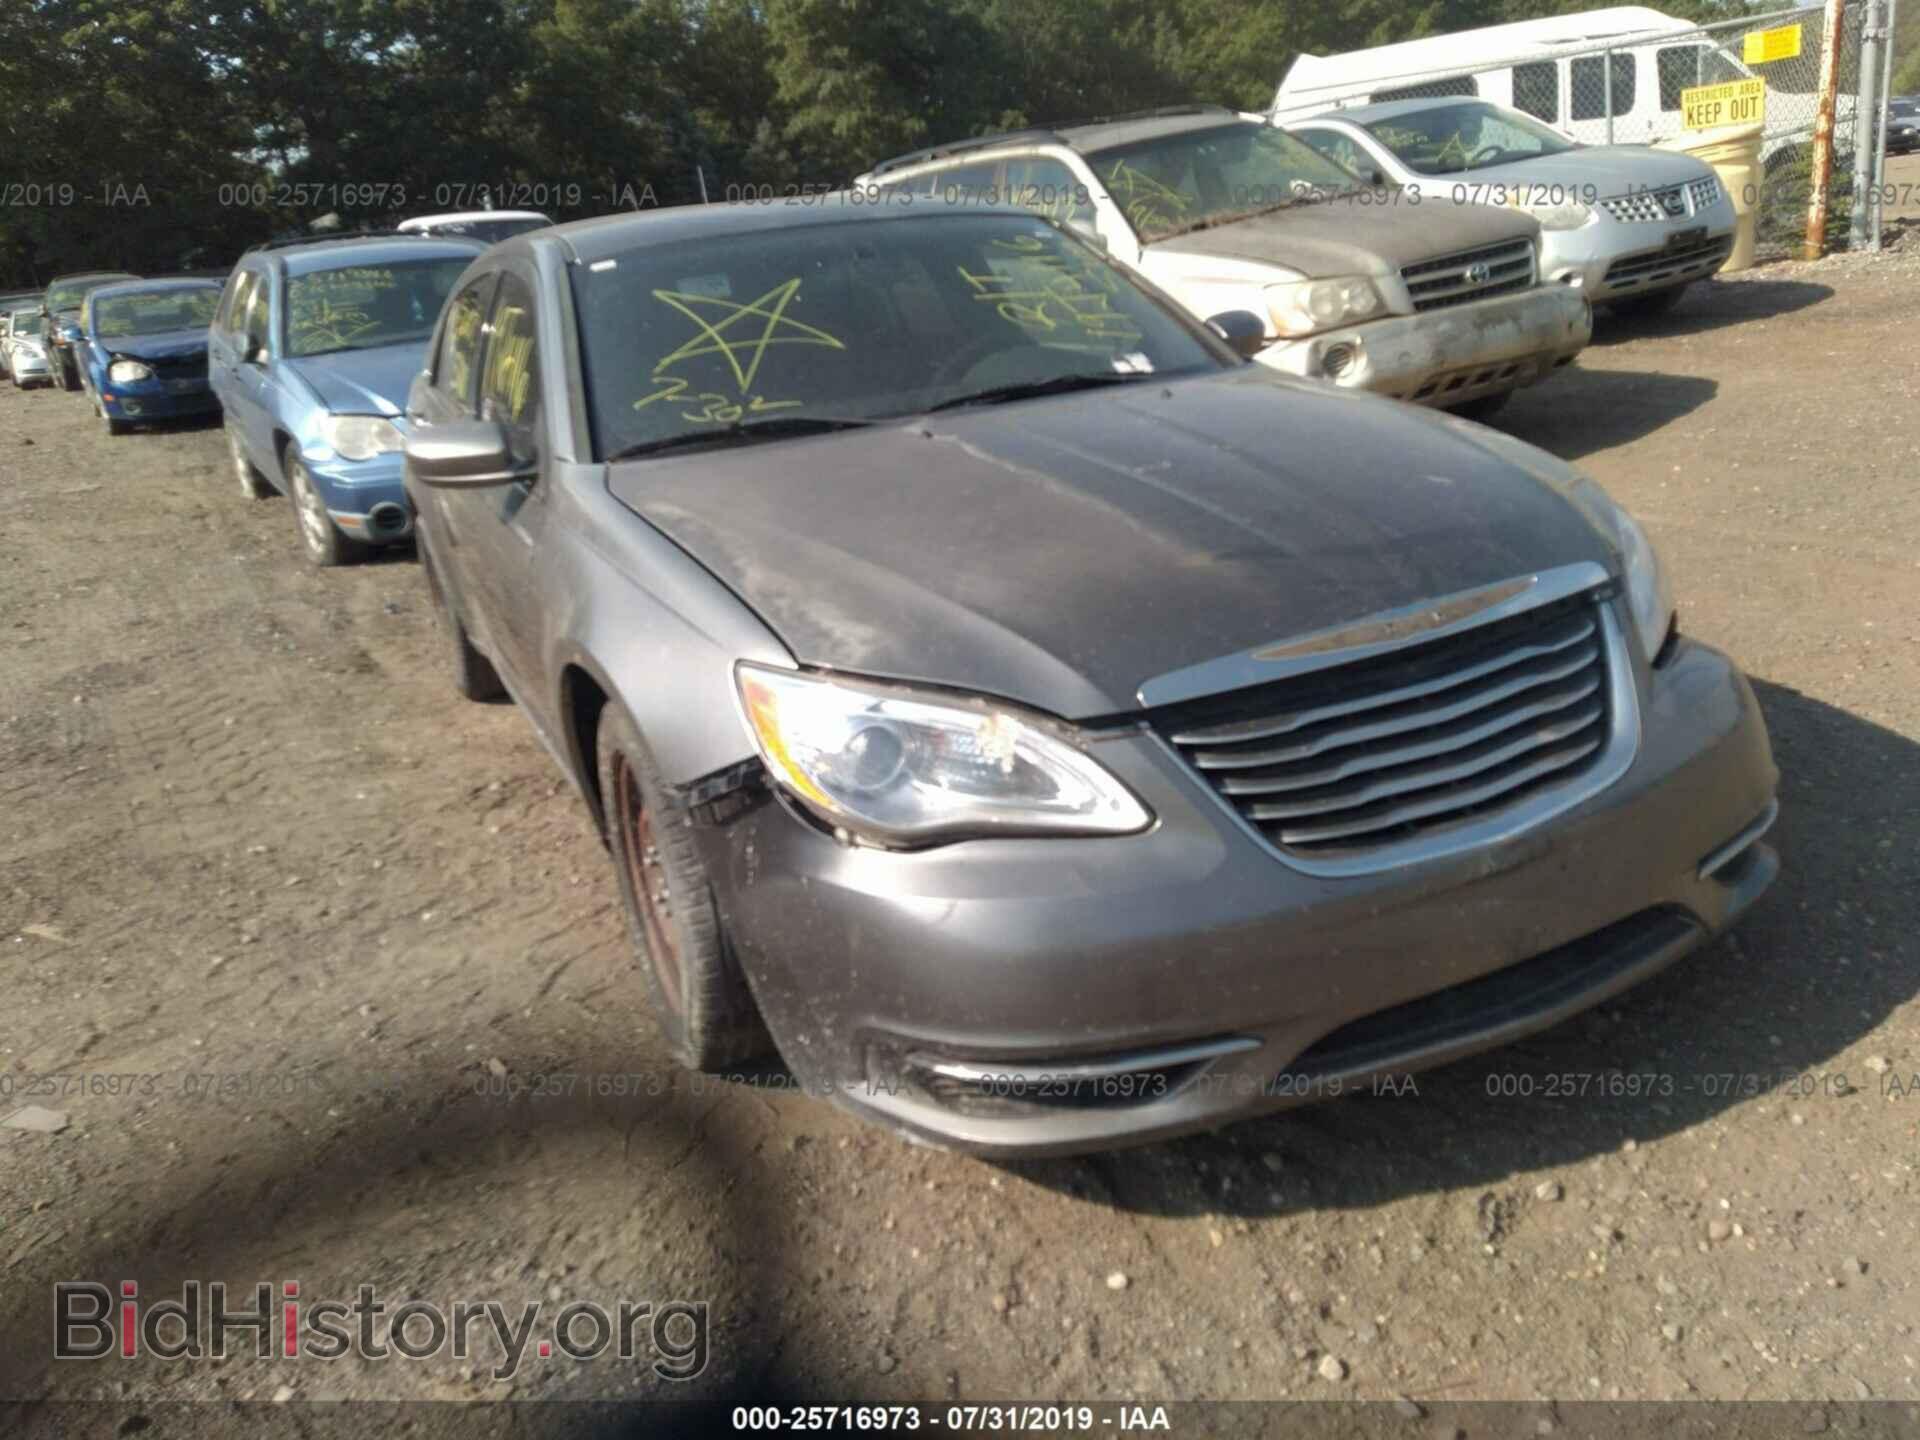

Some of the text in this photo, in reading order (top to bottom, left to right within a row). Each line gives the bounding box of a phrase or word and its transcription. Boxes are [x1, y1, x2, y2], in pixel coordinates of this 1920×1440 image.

[1686, 81, 1761, 103] RESTRICTED AREA
[1687, 96, 1758, 126] KEEP OUT
